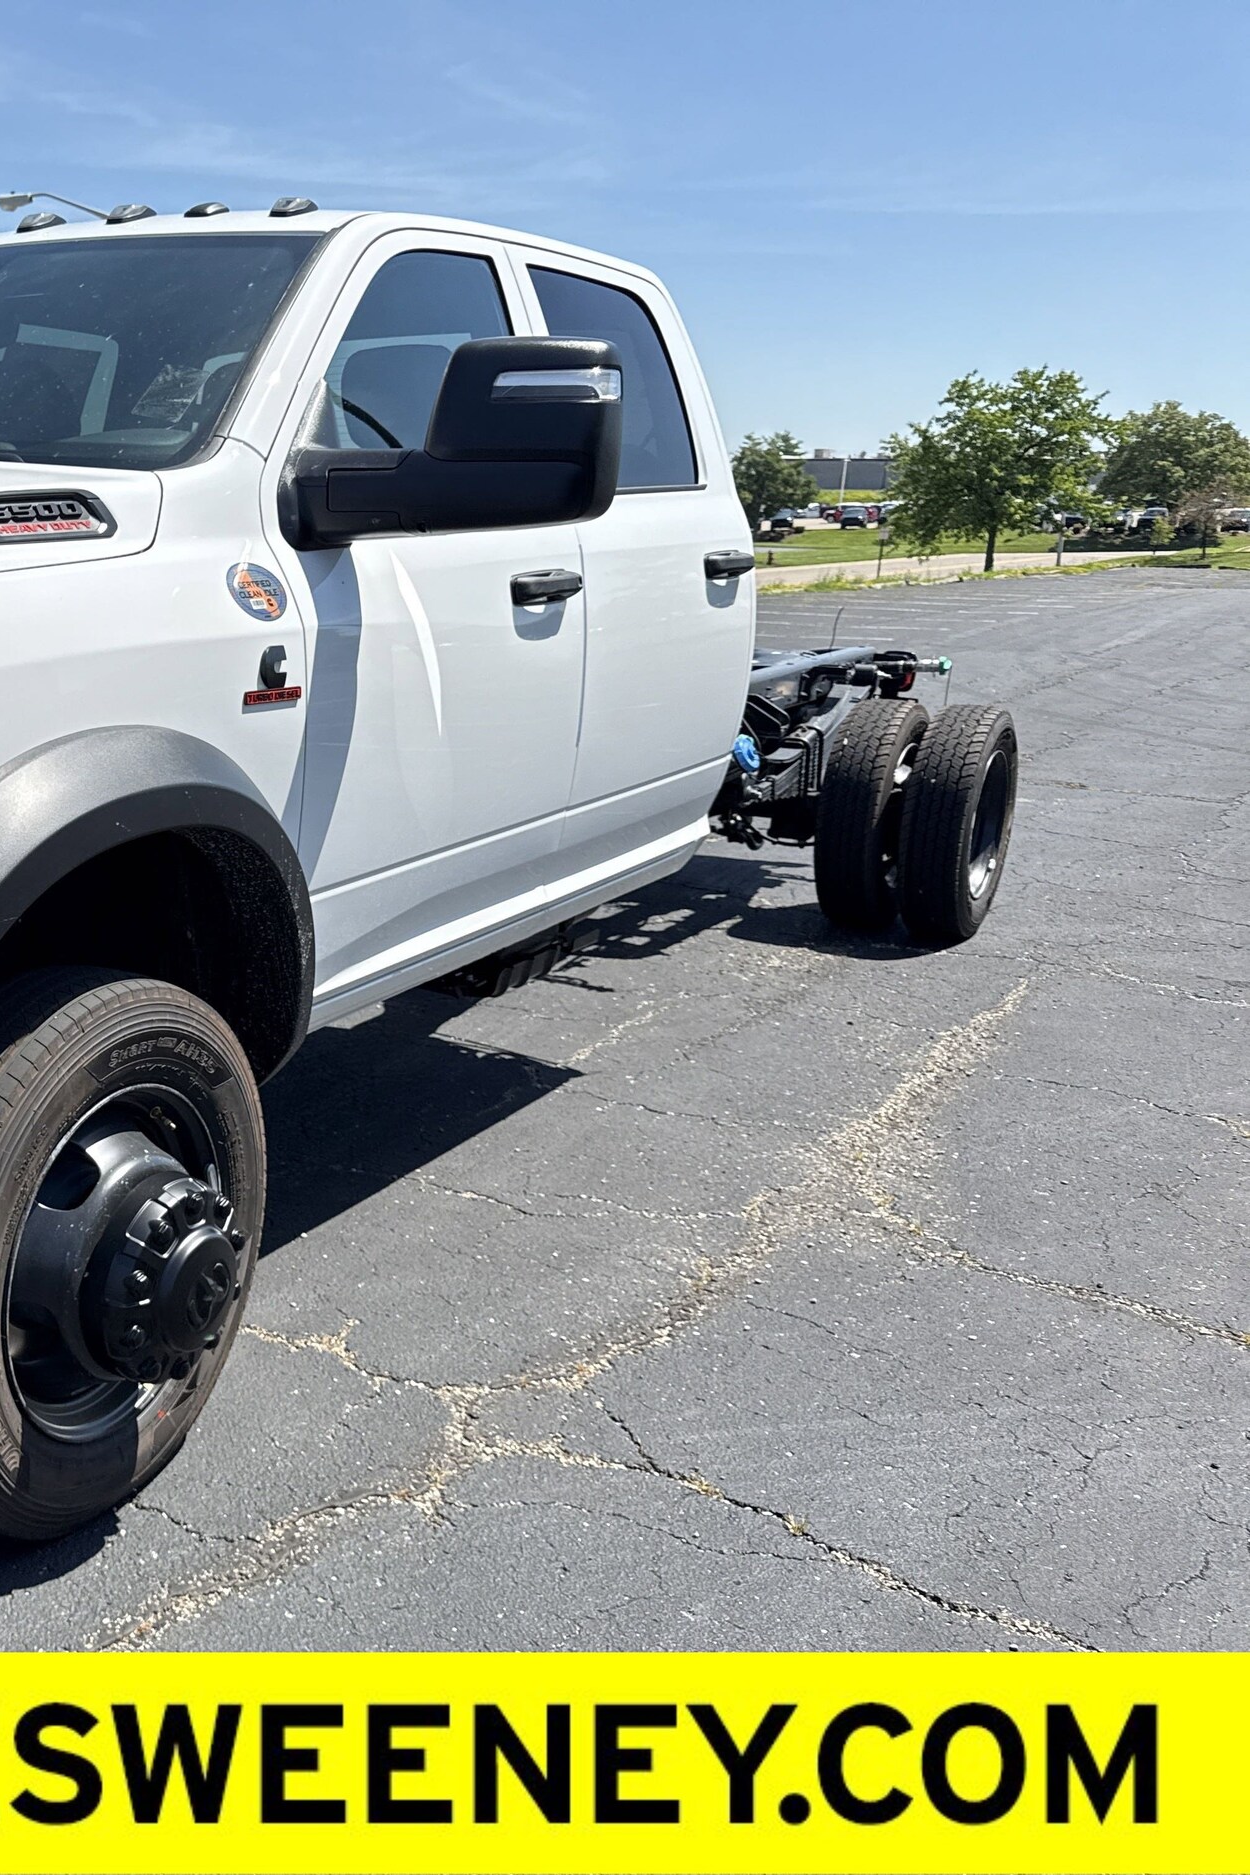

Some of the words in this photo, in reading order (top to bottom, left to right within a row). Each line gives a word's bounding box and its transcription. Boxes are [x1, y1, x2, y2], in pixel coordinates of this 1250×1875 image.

[50, 520, 92, 531] DUTY
[237, 579, 272, 589] CERTIFIED
[239, 590, 263, 599] CLEAN
[247, 692, 274, 704] TURBO
[274, 689, 301, 702] DIESEL
